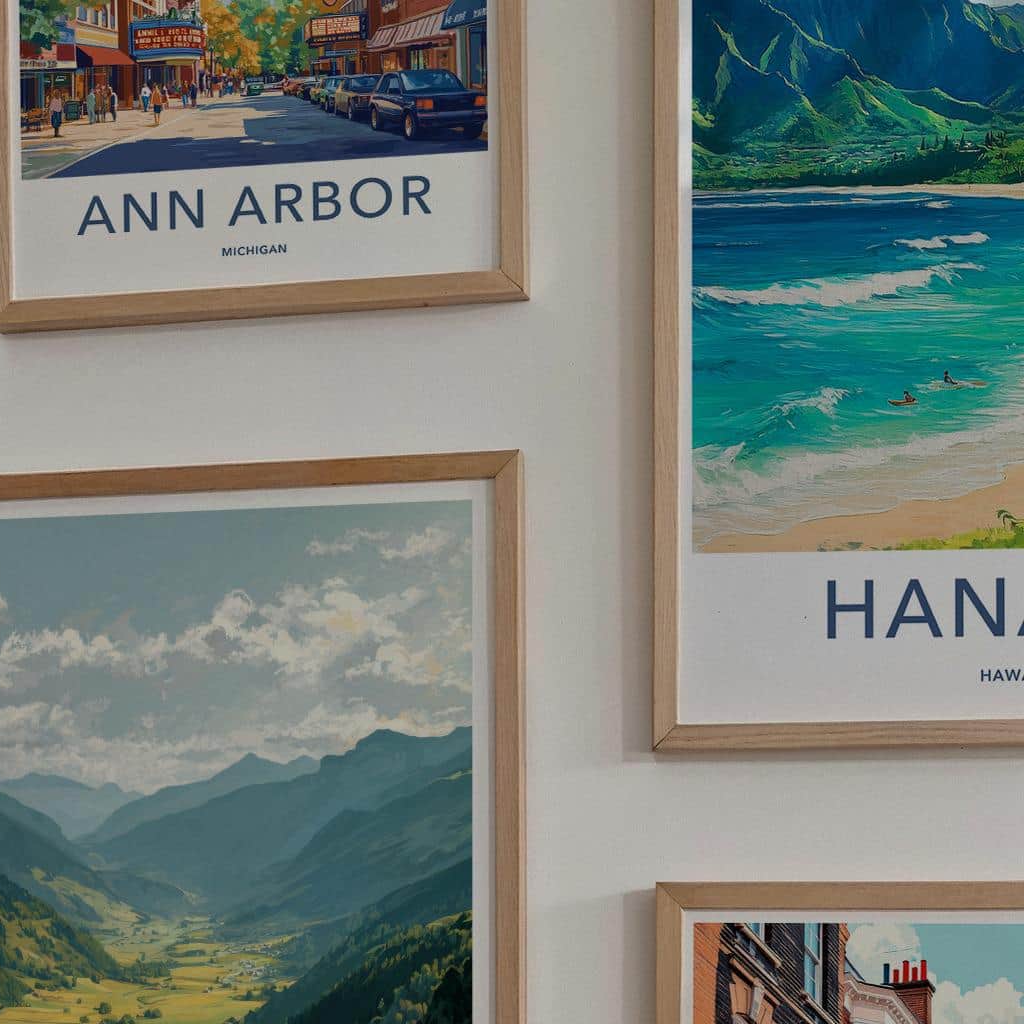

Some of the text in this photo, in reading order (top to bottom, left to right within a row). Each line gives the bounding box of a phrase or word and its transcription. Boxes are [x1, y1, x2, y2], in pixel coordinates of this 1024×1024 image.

[76, 175, 432, 236] ANN ARBOR
[221, 243, 288, 257] MICHIGAN
[827, 577, 1024, 639] HAN
[980, 668, 1024, 682] HAW
